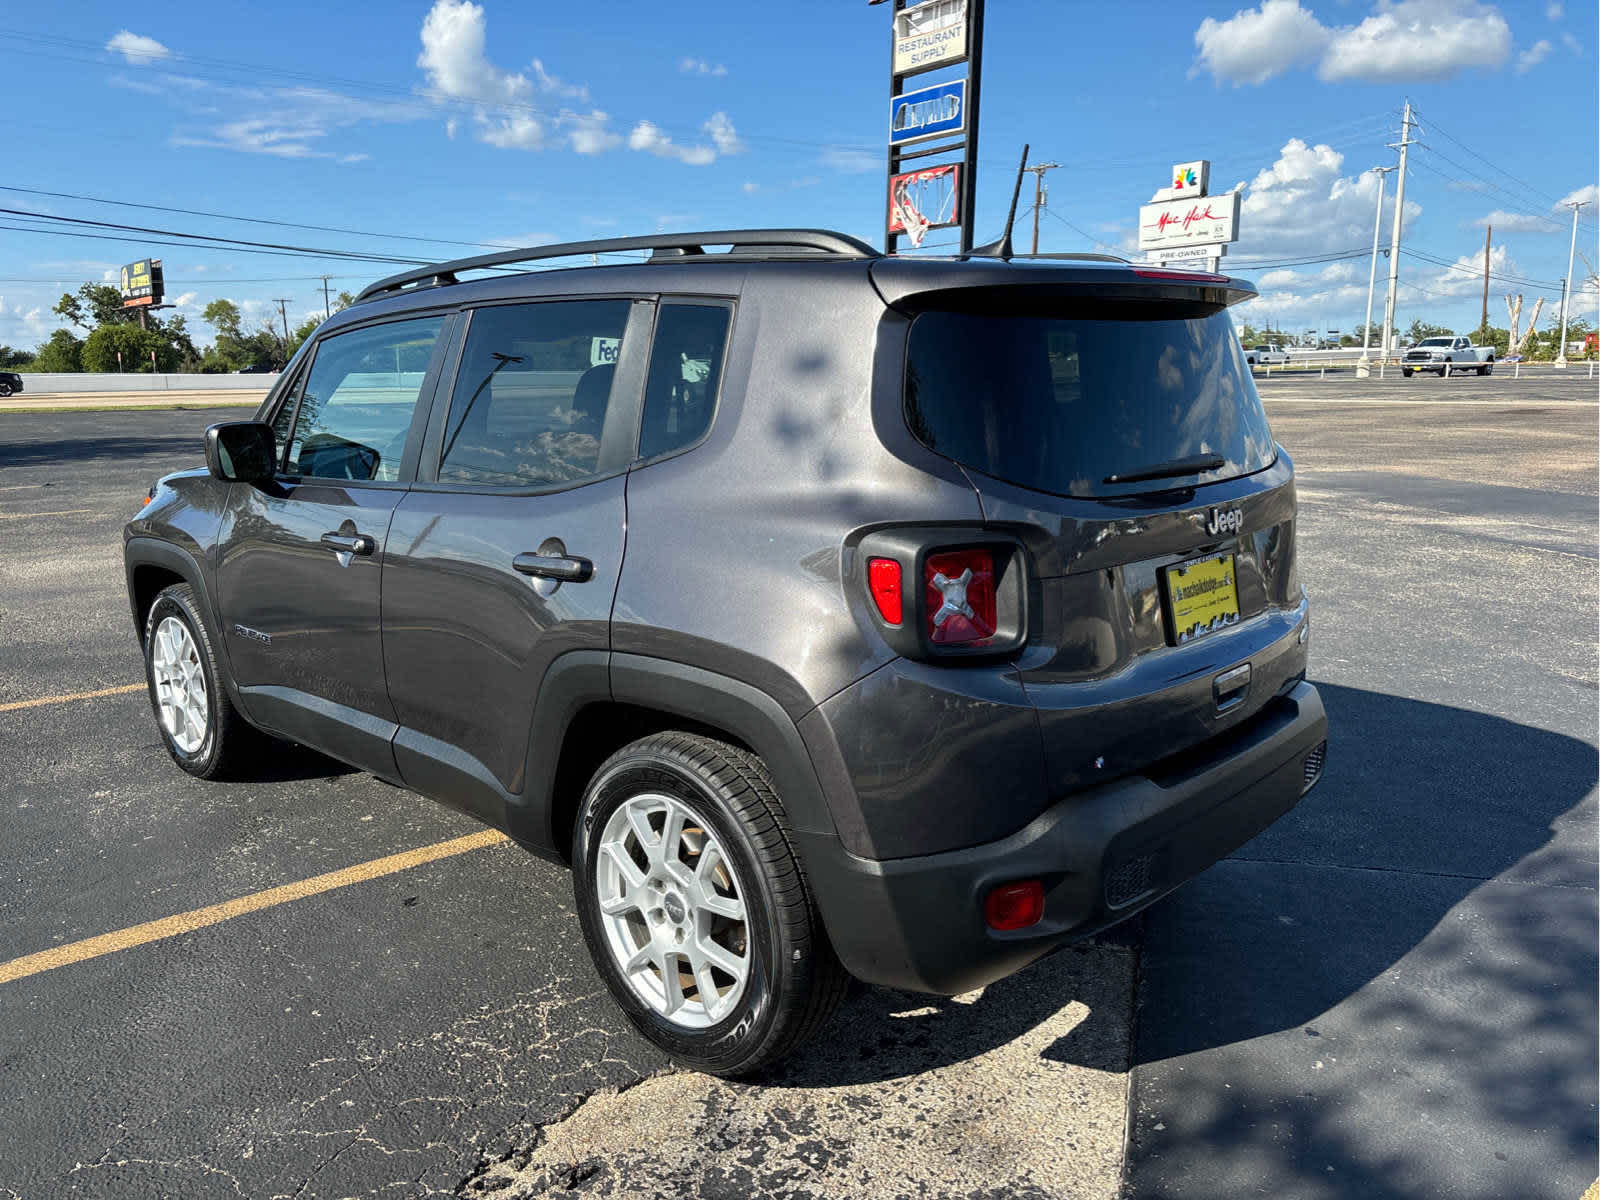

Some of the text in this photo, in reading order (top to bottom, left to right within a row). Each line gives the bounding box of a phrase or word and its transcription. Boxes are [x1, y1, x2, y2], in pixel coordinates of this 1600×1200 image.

[898, 25, 962, 54] RESTAURANT
[911, 43, 948, 64] SUPPLY
[1147, 211, 1182, 233] Mac
[1182, 204, 1225, 231] Haik
[1160, 248, 1208, 259] PRE-OWNED
[1207, 507, 1244, 536] Jeep
